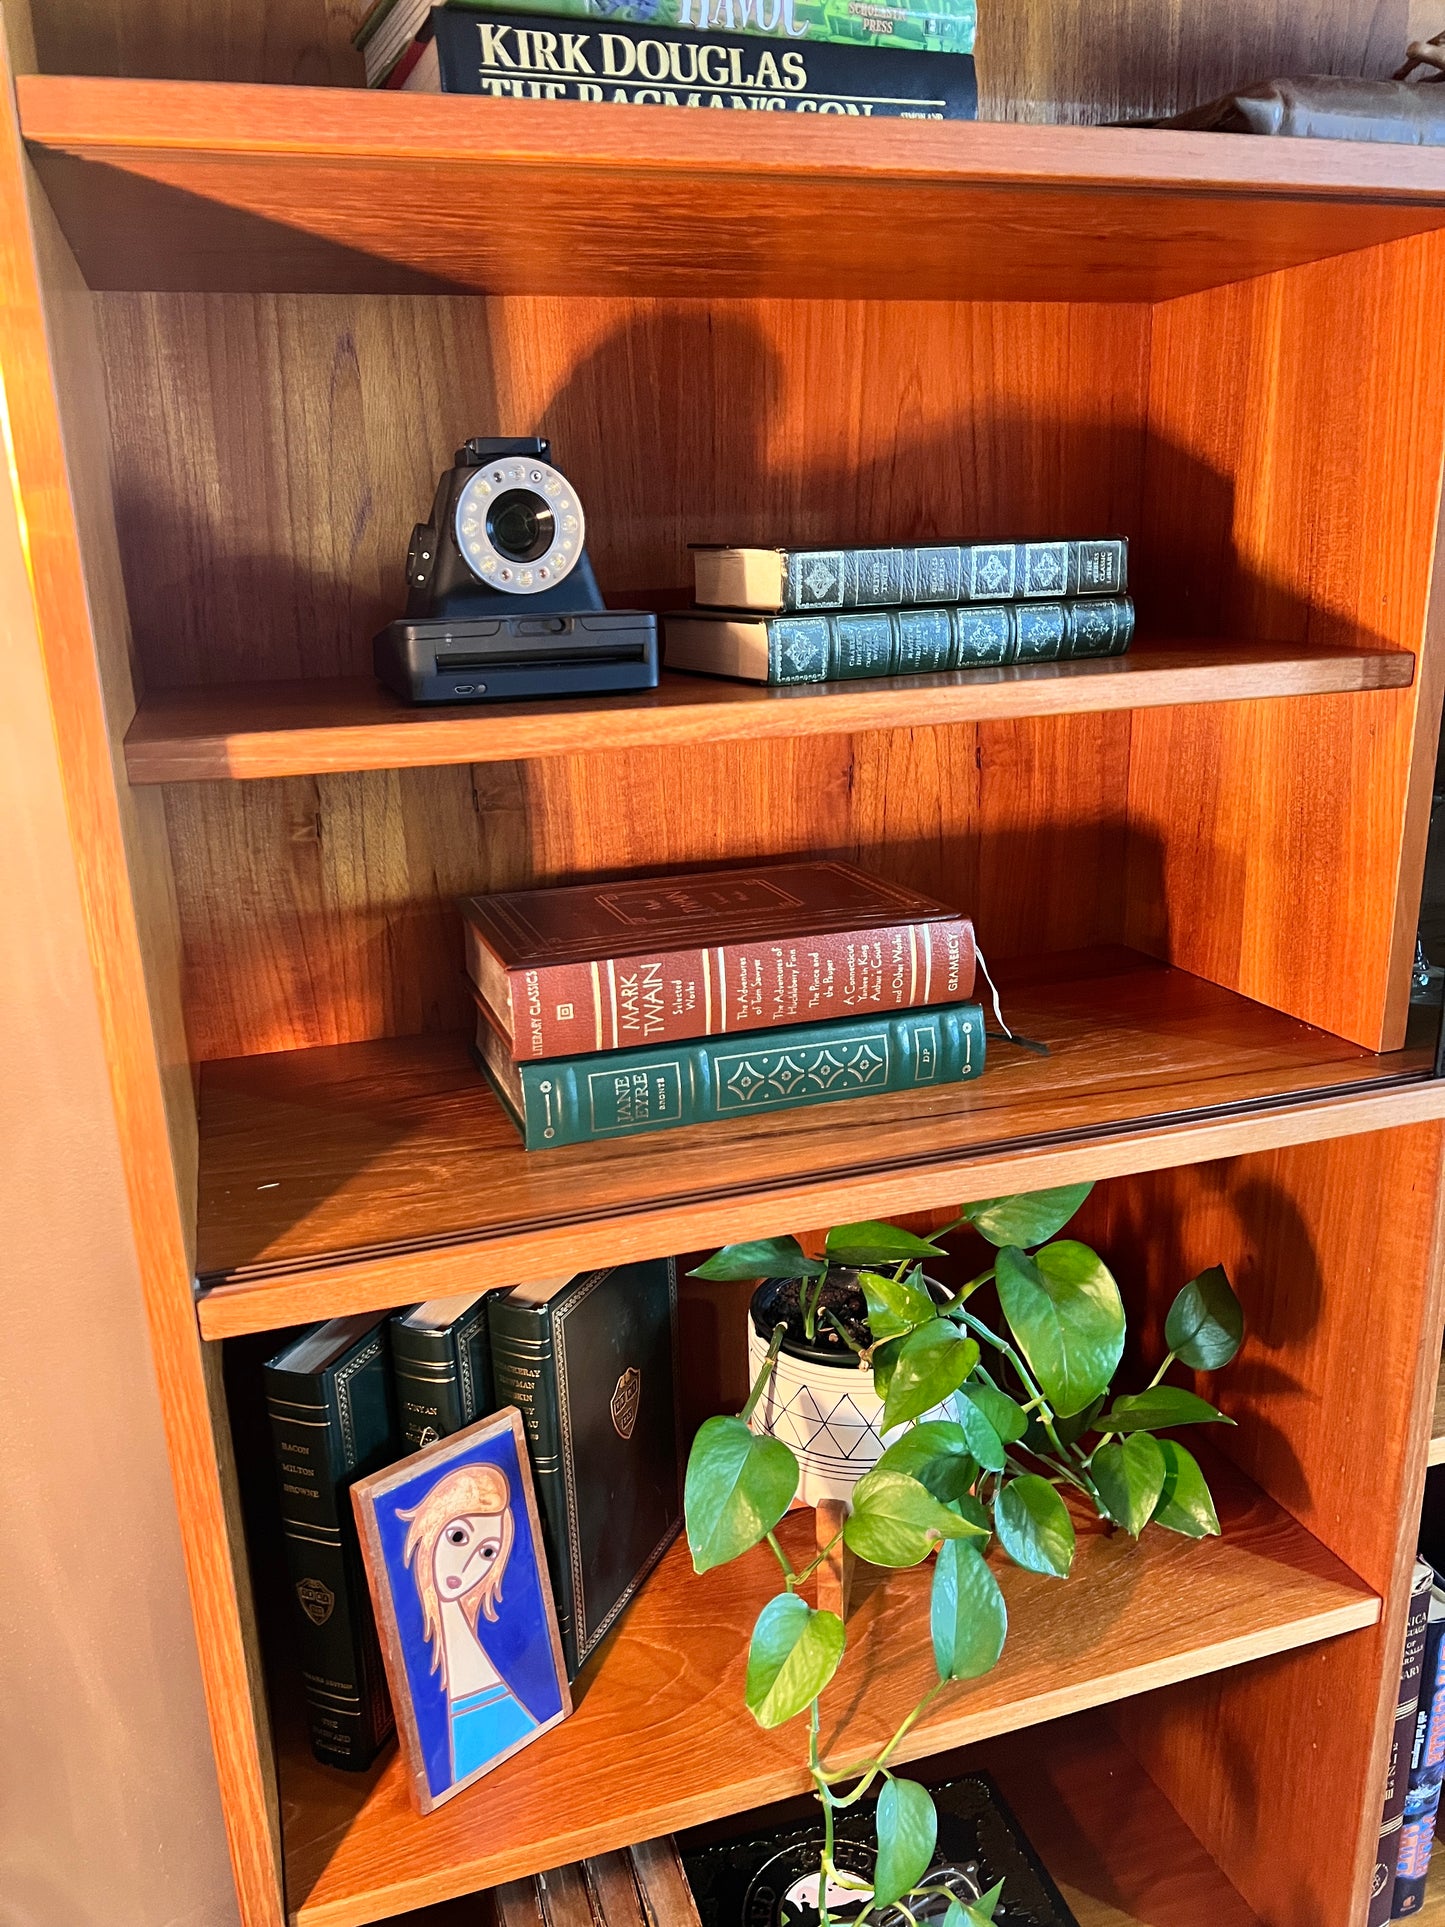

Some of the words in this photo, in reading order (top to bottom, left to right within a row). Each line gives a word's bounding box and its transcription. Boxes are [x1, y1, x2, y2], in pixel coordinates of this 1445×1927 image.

[862, 17, 894, 34] PRESS
[476, 23, 596, 75] KIRK
[599, 33, 808, 91] DOUGLAS
[872, 561, 880, 595] OLIVER
[770, 947, 783, 957] of
[785, 949, 797, 968] Finn
[807, 952, 819, 967] and
[857, 944, 870, 966] King
[870, 941, 883, 969] Court
[891, 933, 903, 964] Works
[948, 932, 960, 992] GRAMERCY
[736, 957, 749, 1003] Adventures
[750, 959, 764, 987] Sawyer
[773, 958, 785, 1003] Adventures
[808, 969, 820, 991] Prince
[822, 959, 836, 984] Pauper
[844, 943, 856, 995] Connecticut
[861, 967, 869, 975] in
[891, 963, 904, 989] Other
[525, 970, 541, 1016] CLASSICS
[671, 979, 683, 1015] Selected
[685, 981, 696, 1011] Works
[751, 988, 762, 1005] Tom
[786, 969, 800, 1015] Huckleberry
[822, 985, 834, 998] the
[857, 976, 869, 1003] Yankee
[870, 969, 882, 1001] Arthur's
[891, 989, 903, 1003] and
[620, 973, 641, 1030] MARK
[640, 962, 665, 1037] TWAIN
[736, 1004, 749, 1020] The
[751, 1006, 763, 1015] of
[772, 1004, 784, 1020] The
[808, 992, 820, 1009] The
[843, 995, 855, 1006] A
[530, 1018, 543, 1056] LITERARY
[922, 1048, 930, 1063] DP
[614, 1075, 634, 1122] JANE
[632, 1072, 649, 1120] EYRE
[281, 1463, 315, 1477] MILTON
